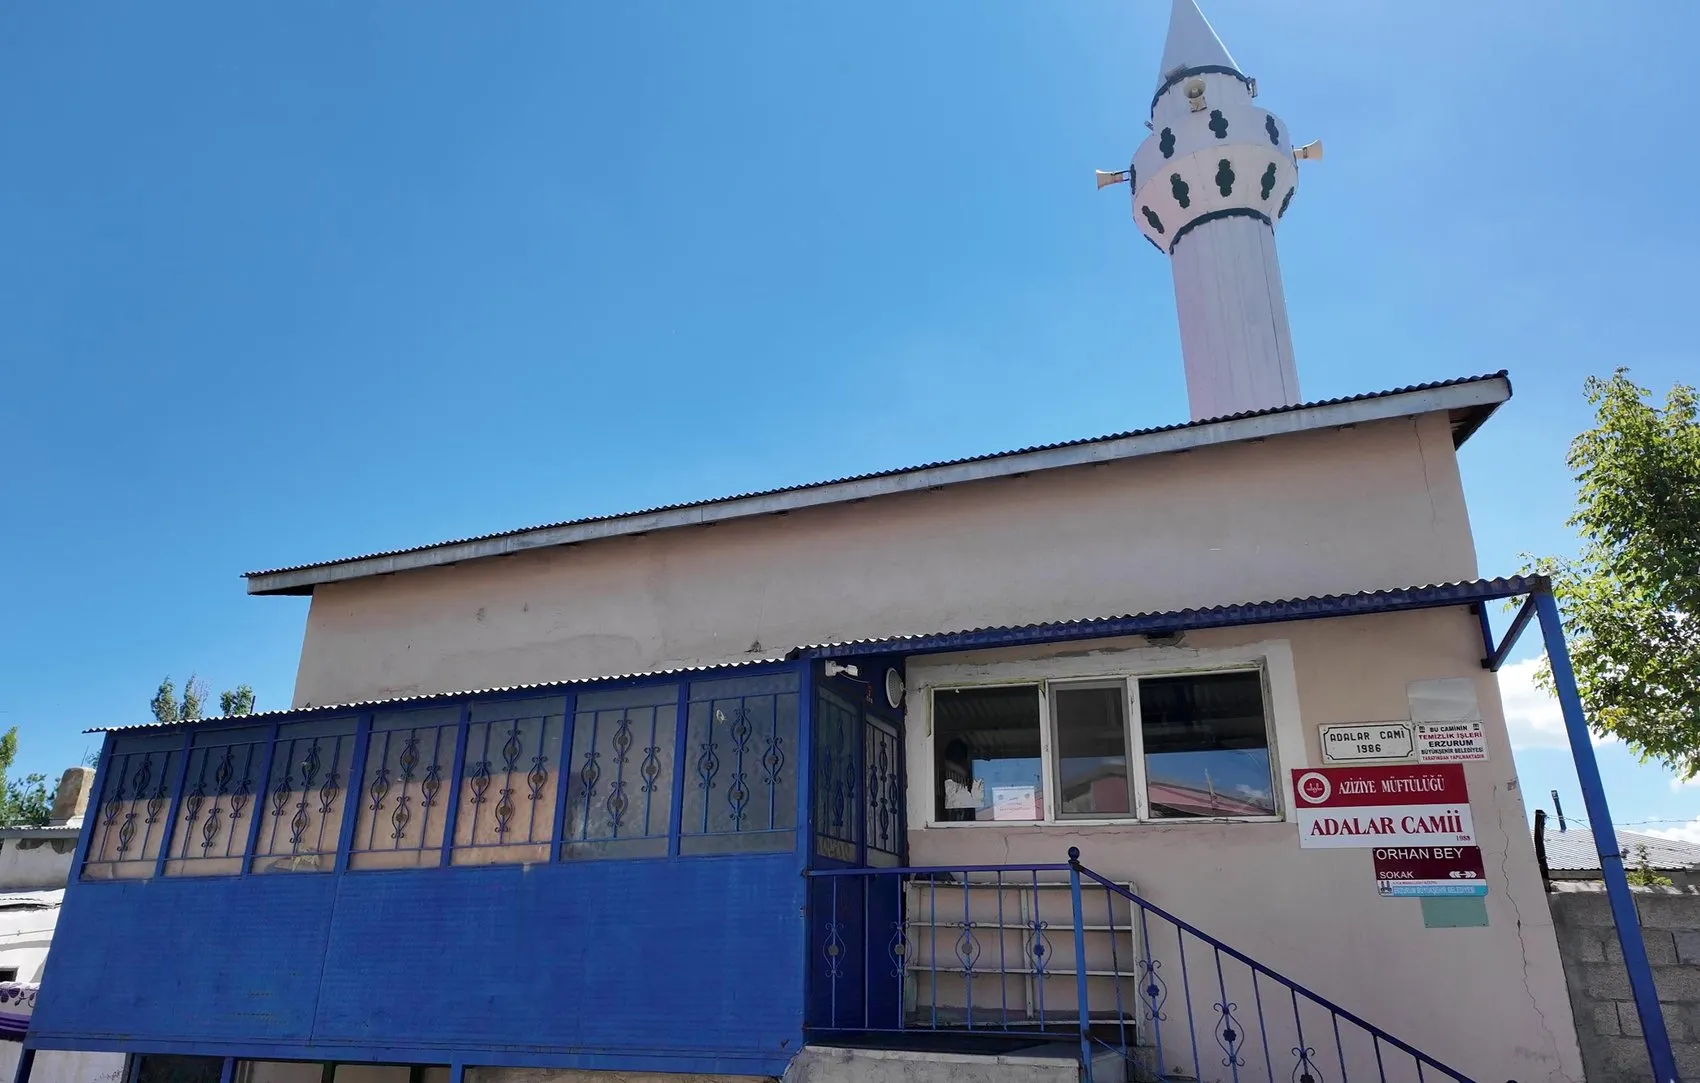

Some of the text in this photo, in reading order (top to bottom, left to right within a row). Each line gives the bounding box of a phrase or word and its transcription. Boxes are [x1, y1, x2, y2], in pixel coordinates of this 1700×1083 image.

[1329, 731, 1370, 742] ADALAR
[1456, 731, 1483, 739] İŞLERİ
[1356, 743, 1382, 753] 1986
[1428, 739, 1474, 748] ERZURUM
[1338, 777, 1377, 795] AZİZİYE
[1381, 774, 1446, 793] MÜFTÜLÜĞÜ
[1310, 816, 1396, 836] ADALAR
[1376, 847, 1464, 860] ORHAN BEY
[1379, 871, 1415, 879] SOKAK
